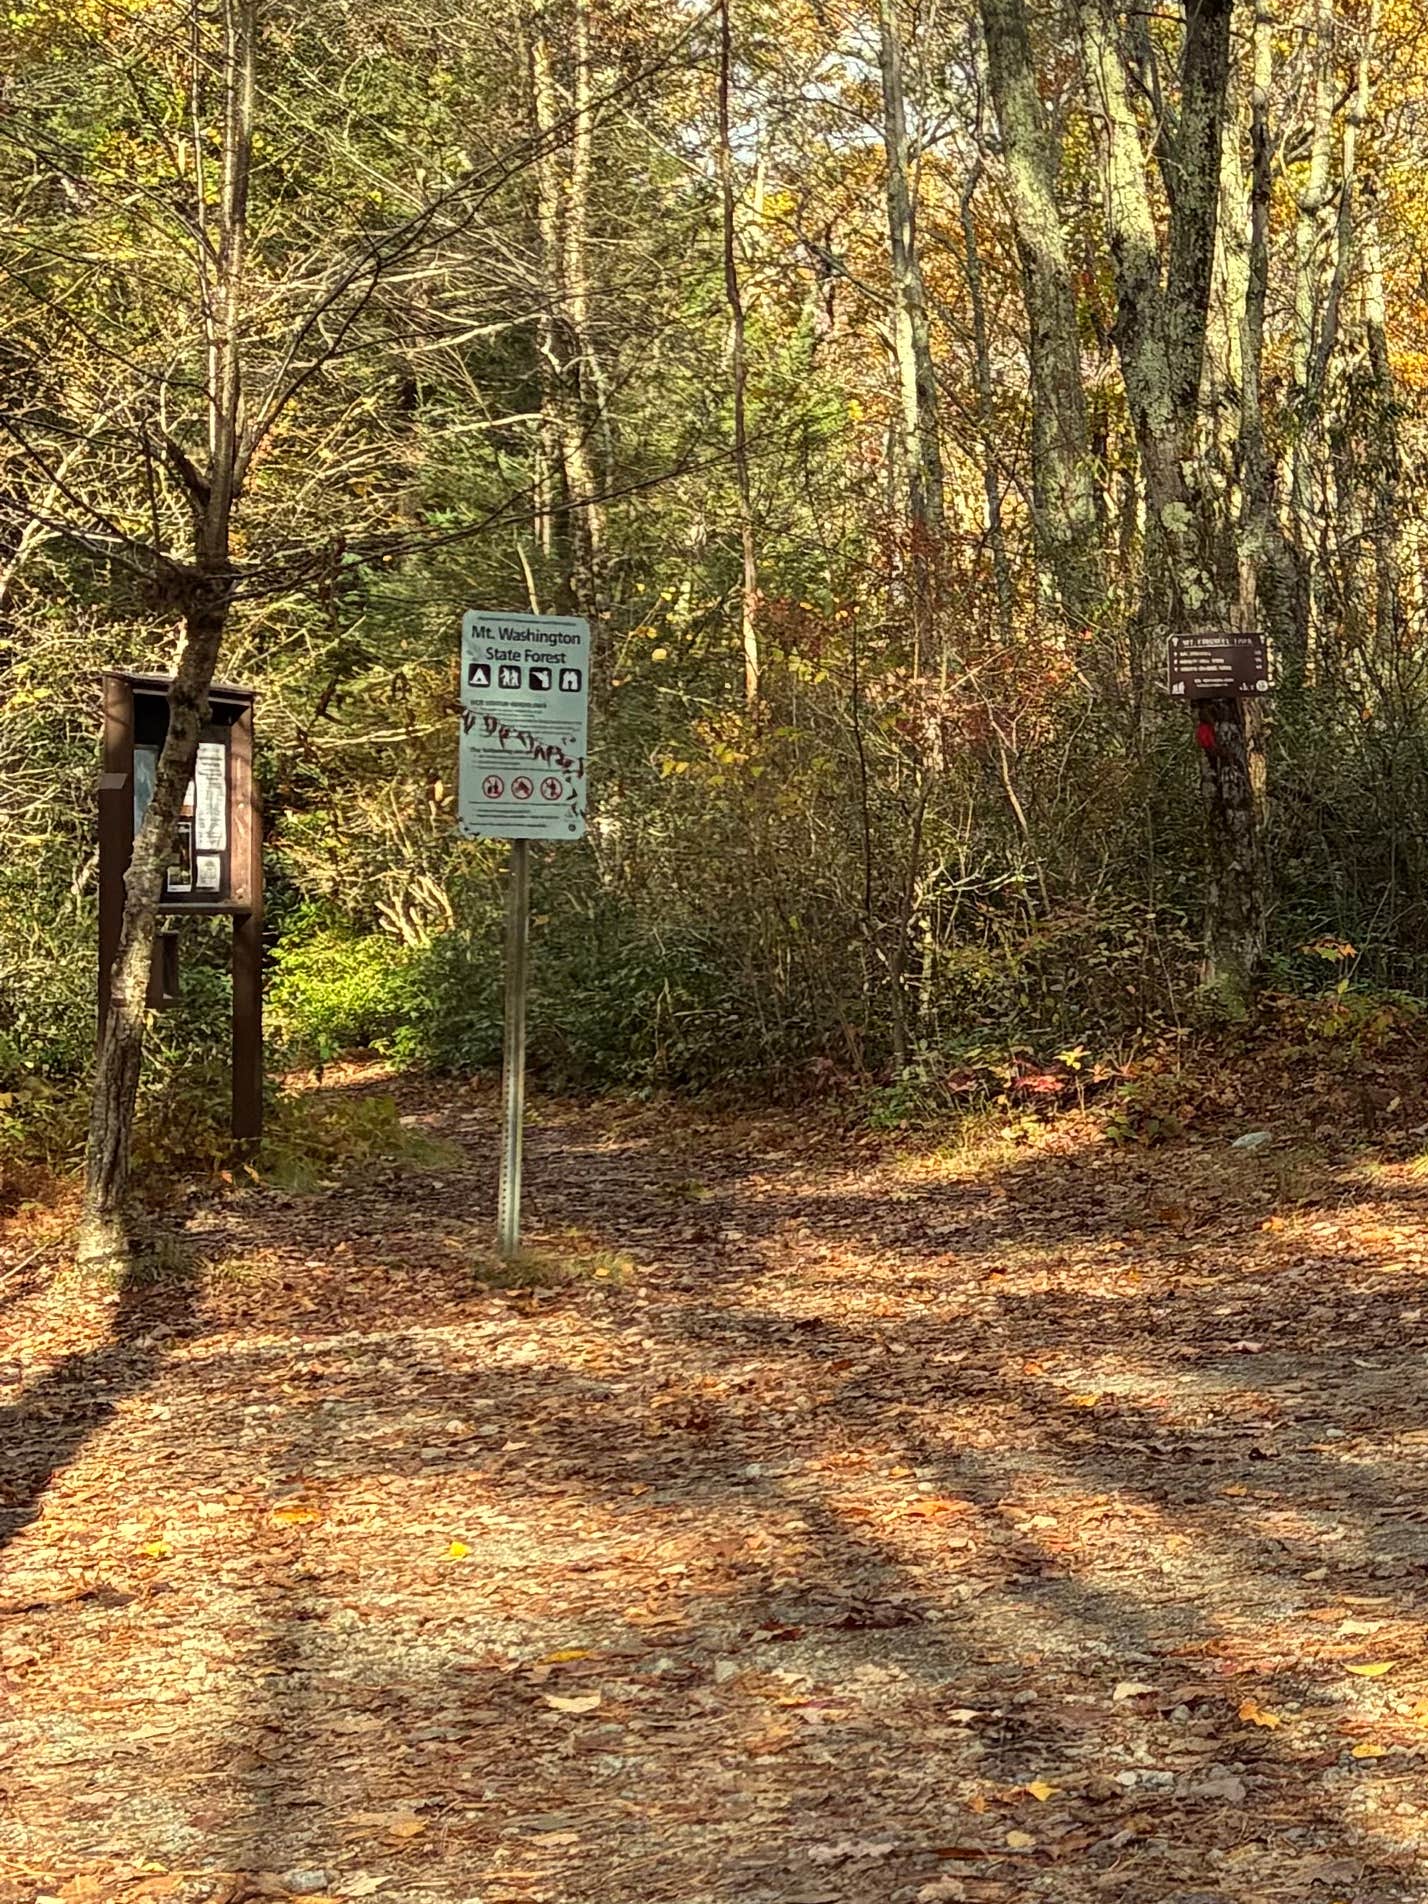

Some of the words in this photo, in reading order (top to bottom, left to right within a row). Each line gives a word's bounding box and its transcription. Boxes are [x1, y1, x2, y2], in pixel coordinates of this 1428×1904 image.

[471, 625, 495, 640] Mt.
[498, 627, 581, 647] Washington
[486, 647, 521, 662] State
[524, 649, 567, 664] Forest
